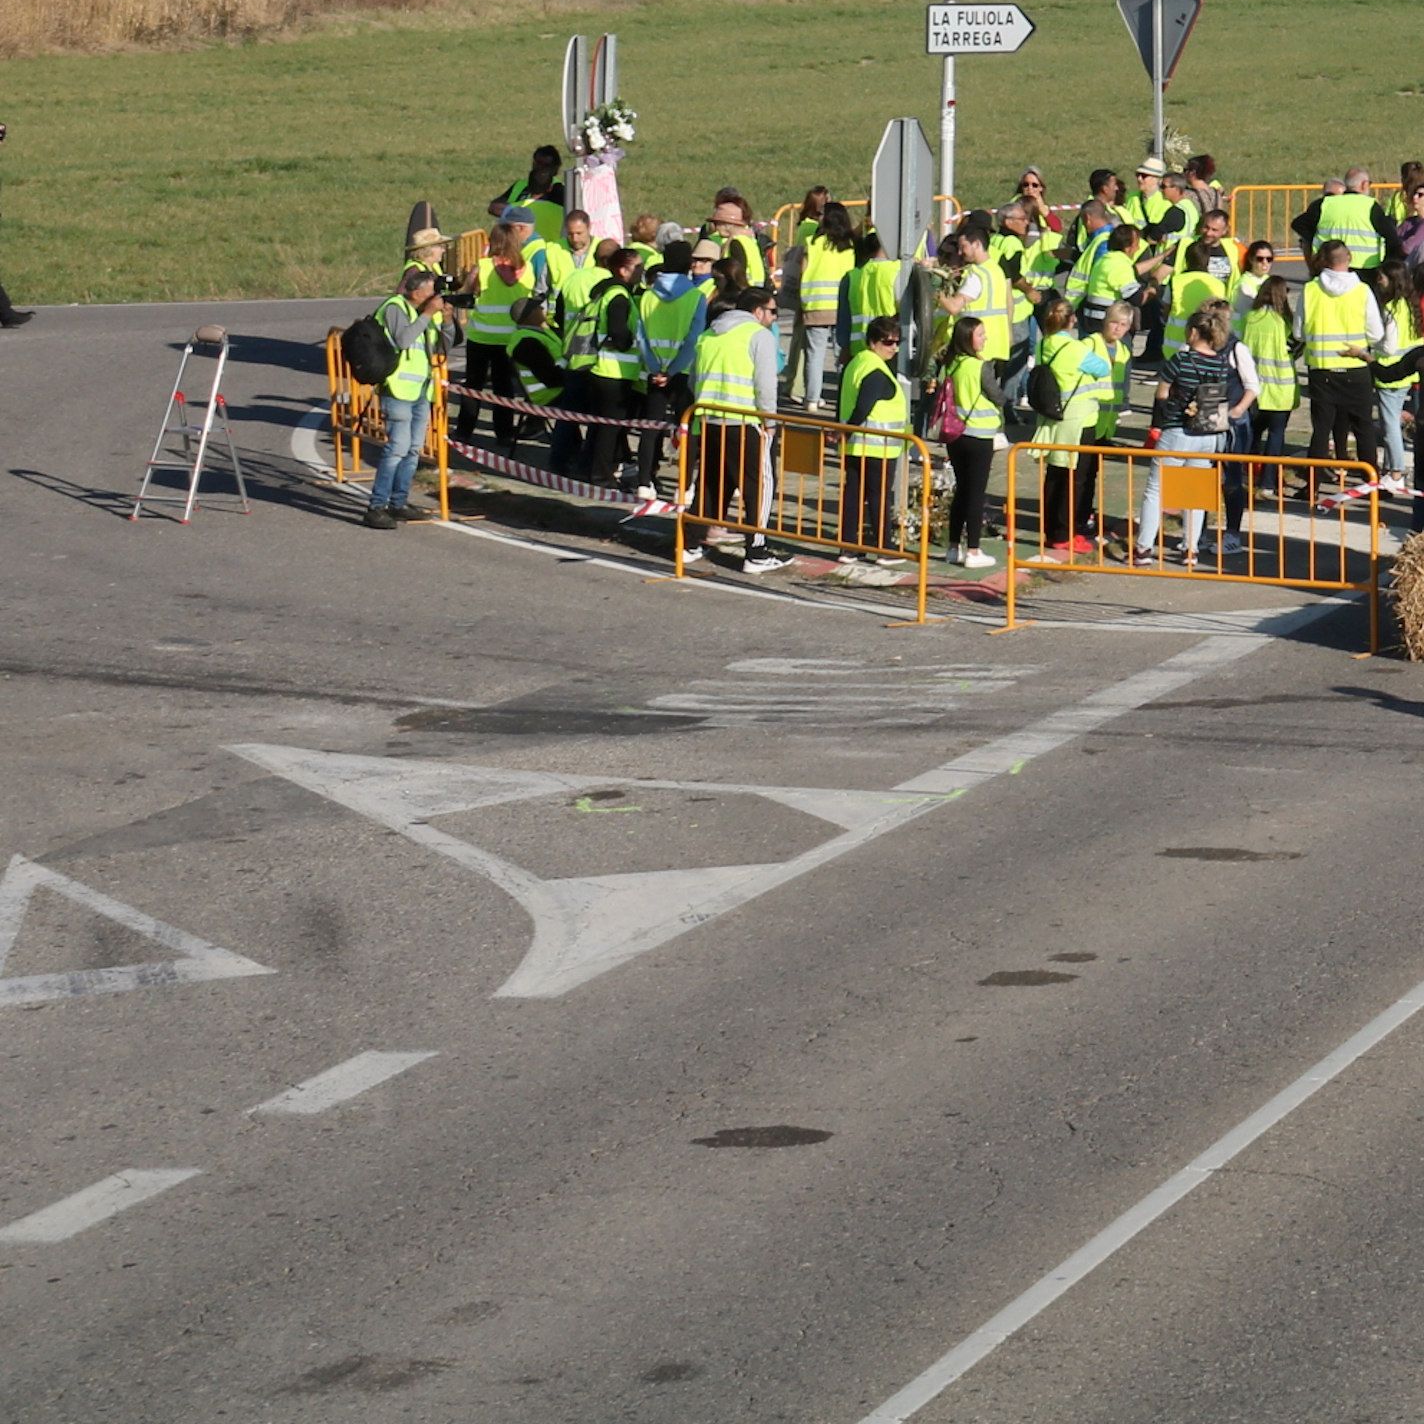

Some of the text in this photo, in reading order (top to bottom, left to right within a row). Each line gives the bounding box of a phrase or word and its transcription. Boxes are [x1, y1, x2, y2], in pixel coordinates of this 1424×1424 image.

[933, 11, 1014, 27] LA FULIOLA
[933, 27, 1002, 46] TÀRREGA
